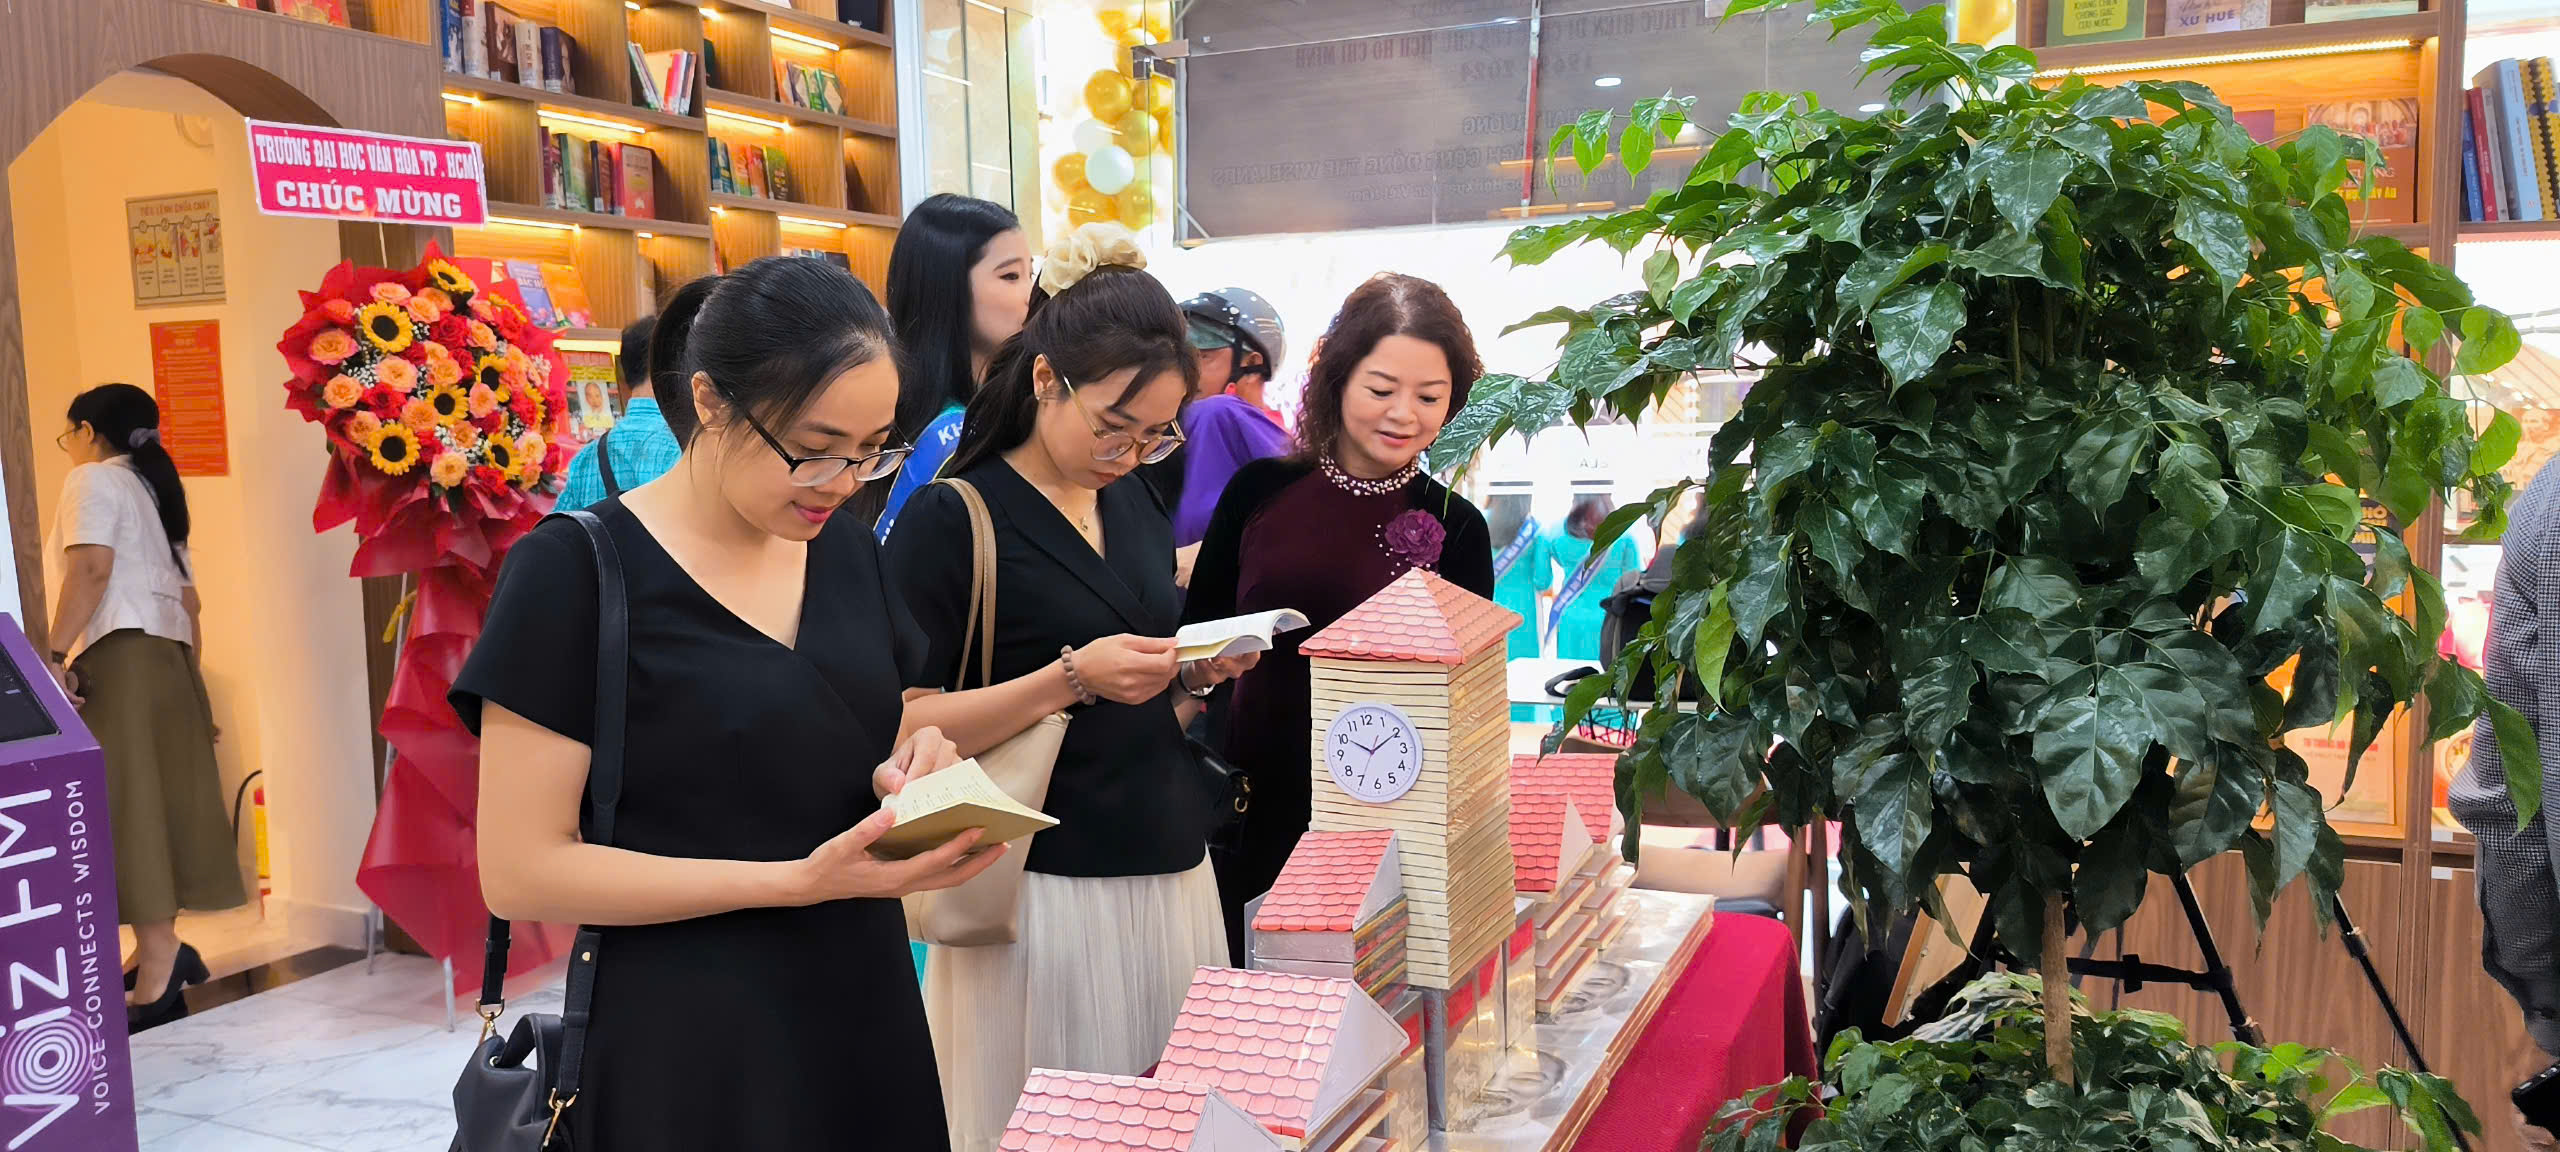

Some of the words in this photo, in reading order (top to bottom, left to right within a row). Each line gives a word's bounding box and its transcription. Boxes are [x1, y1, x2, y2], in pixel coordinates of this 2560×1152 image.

[256, 130, 310, 167] TRƯỜNG
[313, 139, 337, 173] ĐẠI
[340, 141, 366, 176] HỌC
[366, 140, 393, 173] VĂN
[394, 142, 420, 175] HÓA
[276, 178, 365, 211] CHÚC
[375, 186, 461, 218] MỪNG
[1360, 714, 1373, 726] 12
[1380, 717, 1385, 727] 1
[1347, 721, 1358, 732] 11
[1338, 733, 1349, 745] 10
[1393, 727, 1400, 739] 2
[1400, 743, 1408, 754] 3
[1337, 750, 1344, 761] 9
[1345, 765, 1353, 777] 8
[1398, 760, 1406, 771] 4
[1357, 775, 1365, 786] 7
[1374, 778, 1382, 790] 6
[1388, 772, 1396, 784] 5
[65, 780, 91, 883] WISDOM
[76, 892, 104, 1030] CONNECTS
[90, 1038, 111, 1115] VOICE
